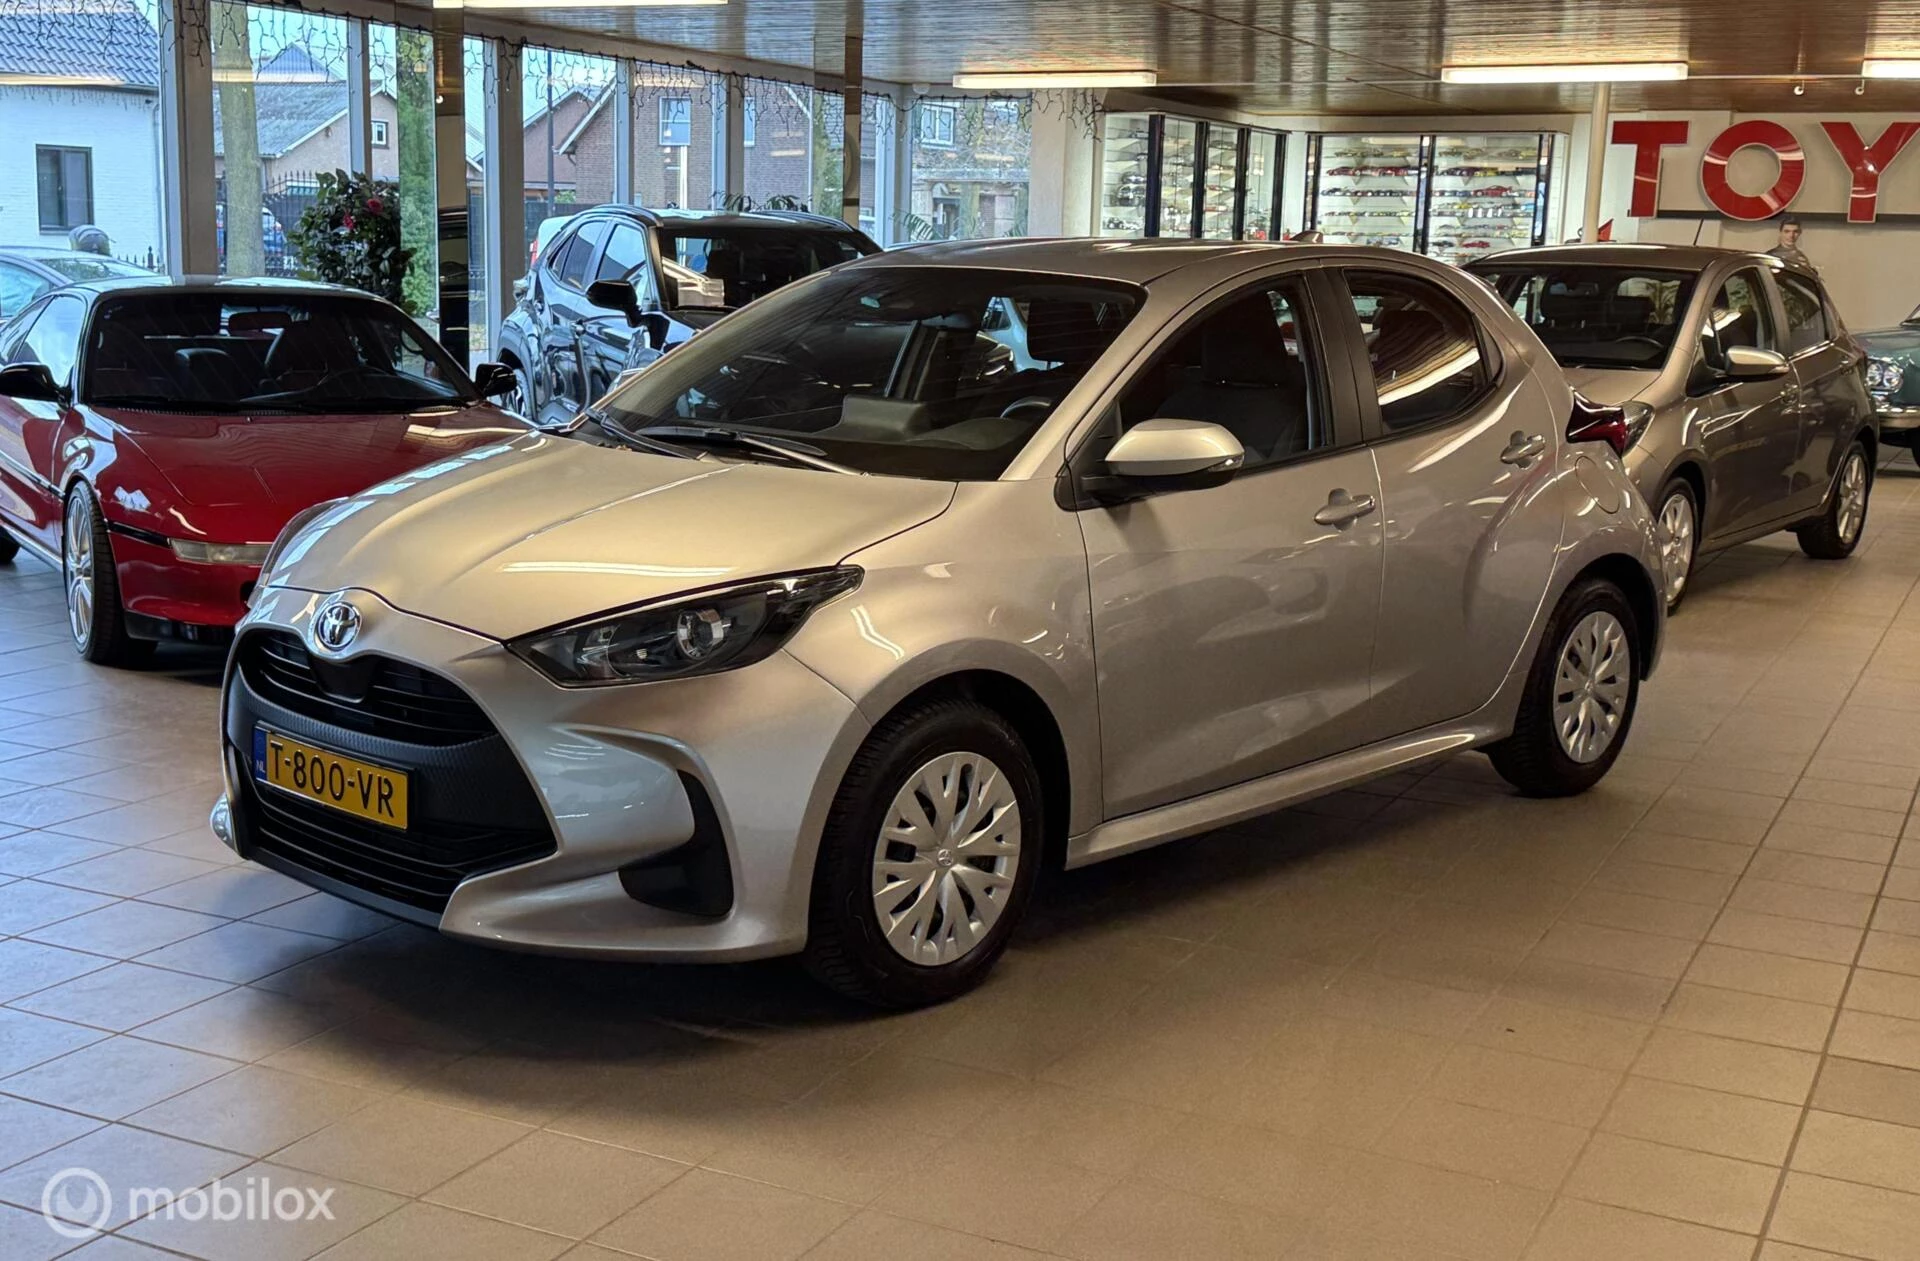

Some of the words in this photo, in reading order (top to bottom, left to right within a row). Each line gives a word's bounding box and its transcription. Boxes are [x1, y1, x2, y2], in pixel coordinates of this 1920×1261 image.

[1611, 119, 1920, 223] TOY
[256, 760, 266, 774] NL
[270, 740, 395, 819] T-800-VR
